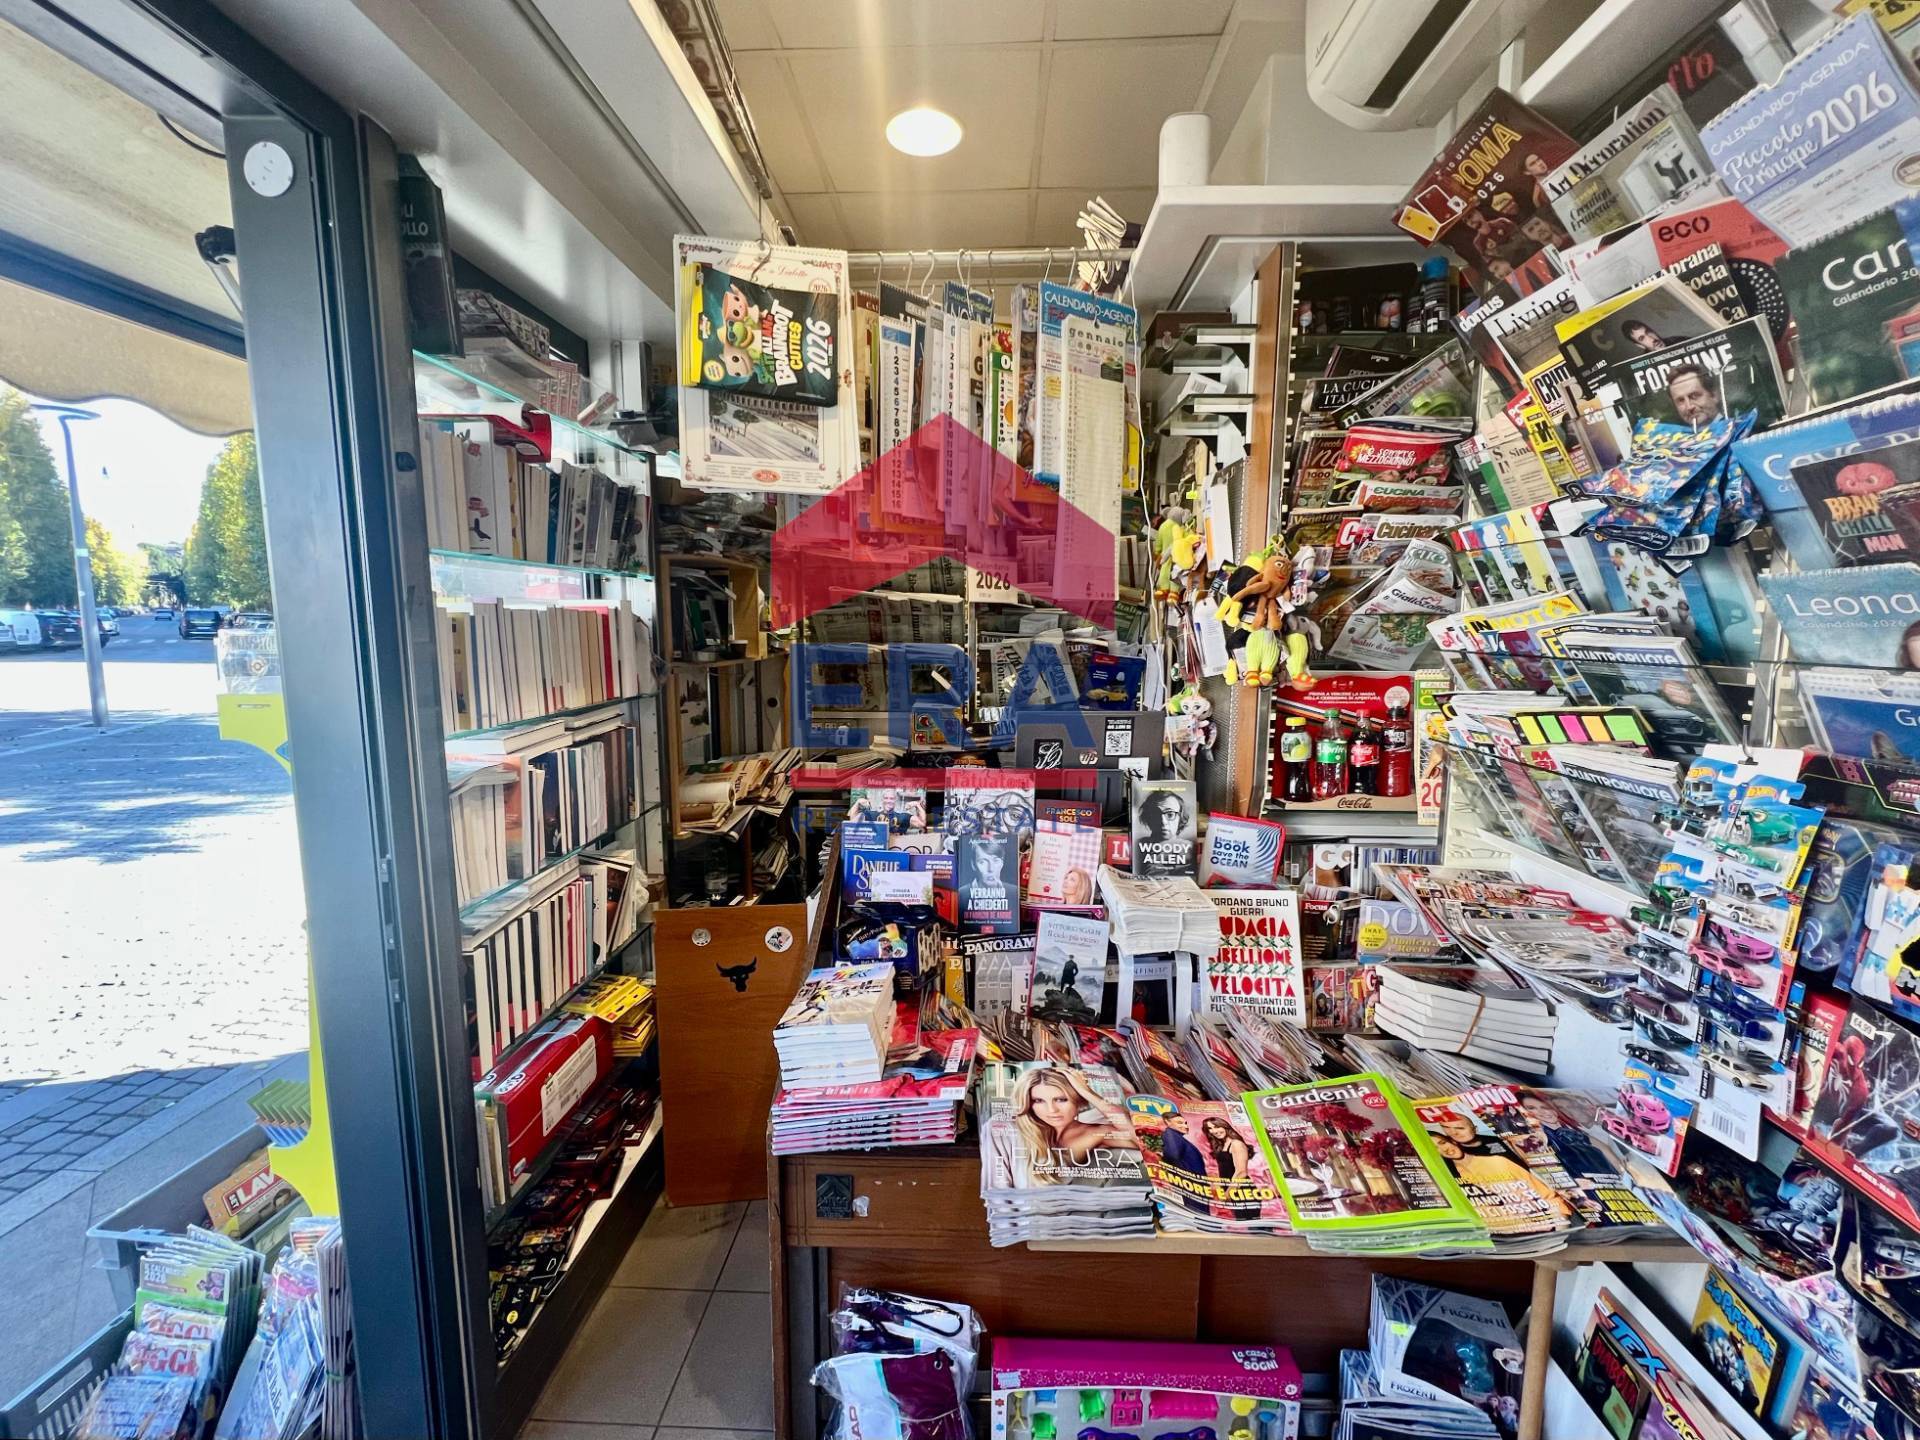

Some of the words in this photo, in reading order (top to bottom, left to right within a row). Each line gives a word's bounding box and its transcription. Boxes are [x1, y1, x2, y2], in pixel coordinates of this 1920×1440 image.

[1806, 71, 1898, 149] 2026
[1723, 121, 1804, 179] Piccolo
[1476, 171, 1506, 200] 026
[1658, 216, 1710, 242] eco
[1833, 278, 1898, 307] Calendario
[1458, 294, 1505, 334] domus
[1493, 285, 1574, 338] Living
[771, 299, 798, 387] BRAINROT
[1069, 326, 1124, 348] gennaio
[788, 321, 804, 371] CUTIES
[805, 316, 832, 381] 2026
[1322, 382, 1341, 394] LA
[1307, 471, 1331, 480] 1000
[1373, 486, 1425, 496] CUCINA
[975, 570, 1011, 592] 2026
[1786, 591, 1920, 617] Leona
[1470, 619, 1491, 634] IN
[1872, 620, 1907, 628] 2026
[1046, 807, 1093, 818] FRANCESCO
[1138, 842, 1191, 854] WOODY
[1213, 836, 1250, 853] book
[1143, 854, 1186, 865] ALLEN
[1210, 856, 1248, 868] OCEAN
[1212, 850, 1233, 858] save
[1235, 852, 1249, 860] the
[853, 854, 900, 875] DANIELLE
[970, 887, 1006, 899] VERRANNO
[974, 899, 1009, 911] CHIEDERTI
[1256, 898, 1289, 907] BRUNO
[1304, 903, 1327, 911] Focus
[1230, 907, 1264, 916] GUERRI
[1218, 916, 1291, 937] UDACIA
[1229, 996, 1282, 1006] STRABILIANTI
[1258, 1005, 1297, 1016] ITALIANI
[1261, 1084, 1370, 1110] Gardenia
[1130, 1100, 1172, 1116] TV
[1010, 1148, 1140, 1169] FUTURA
[1147, 1166, 1214, 1198] L'AMORE
[1229, 1187, 1274, 1201] CIECO
[1441, 1305, 1494, 1325] FROZEN
[1608, 1313, 1671, 1382] TEX
[1243, 1359, 1279, 1371] SOGNI
[1390, 1381, 1428, 1398] FROZEN
